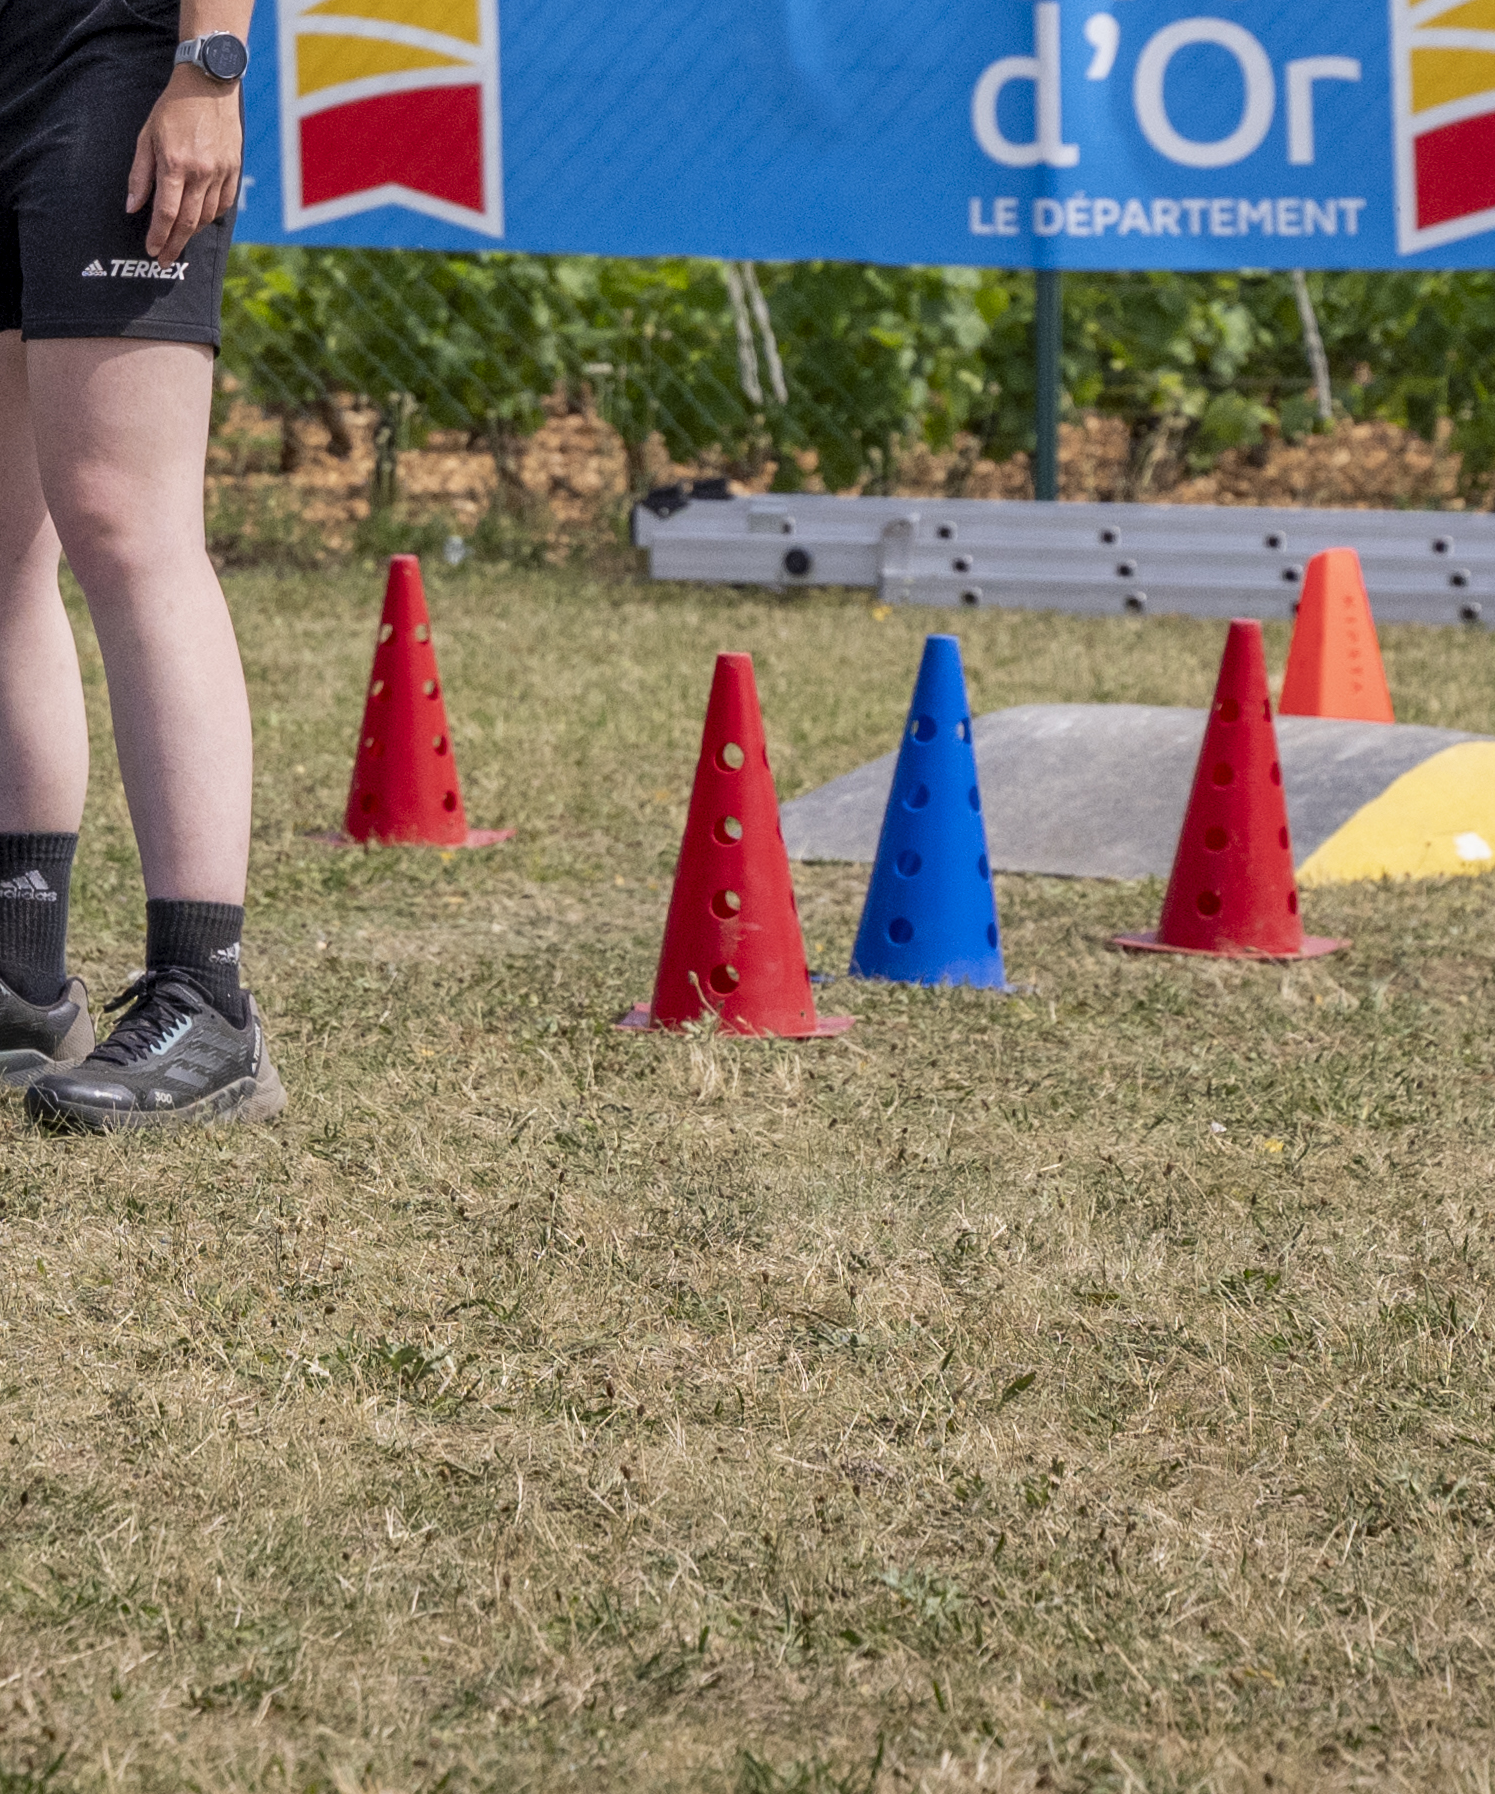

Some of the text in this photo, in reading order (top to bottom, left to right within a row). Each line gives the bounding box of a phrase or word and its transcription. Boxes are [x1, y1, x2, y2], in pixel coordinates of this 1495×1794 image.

[970, 0, 1362, 169] d'Or
[967, 190, 1367, 237] LE DÉPARTEMENT
[110, 258, 190, 281] TERREX
[154, 1091, 173, 1104] 300
